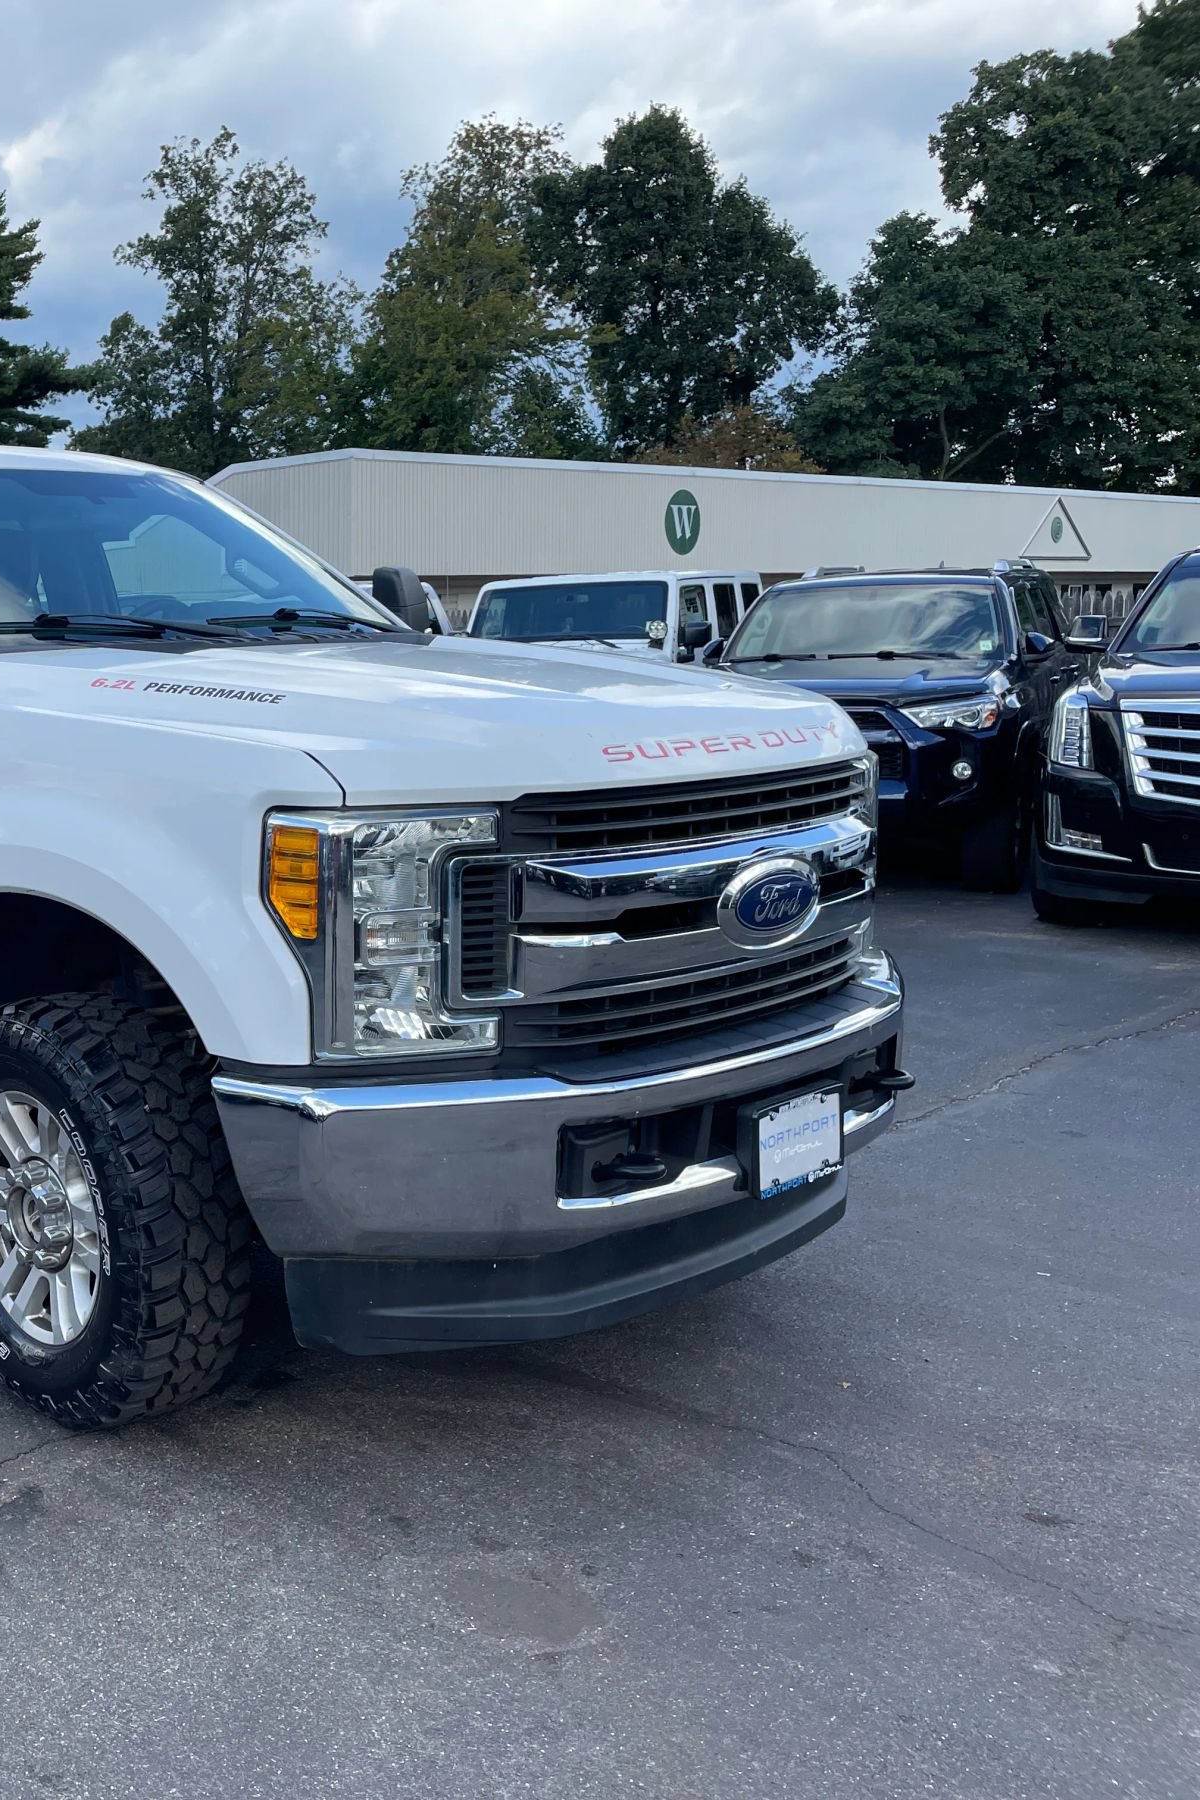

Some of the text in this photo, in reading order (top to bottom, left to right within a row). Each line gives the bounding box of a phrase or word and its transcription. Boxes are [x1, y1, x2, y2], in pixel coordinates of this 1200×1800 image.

[670, 504, 697, 540] W
[90, 677, 287, 704] 6.2L PERFORMANCE
[601, 722, 840, 762] SUPER DUTY
[755, 882, 802, 923] Ford
[760, 1114, 837, 1151] NORTHPORT
